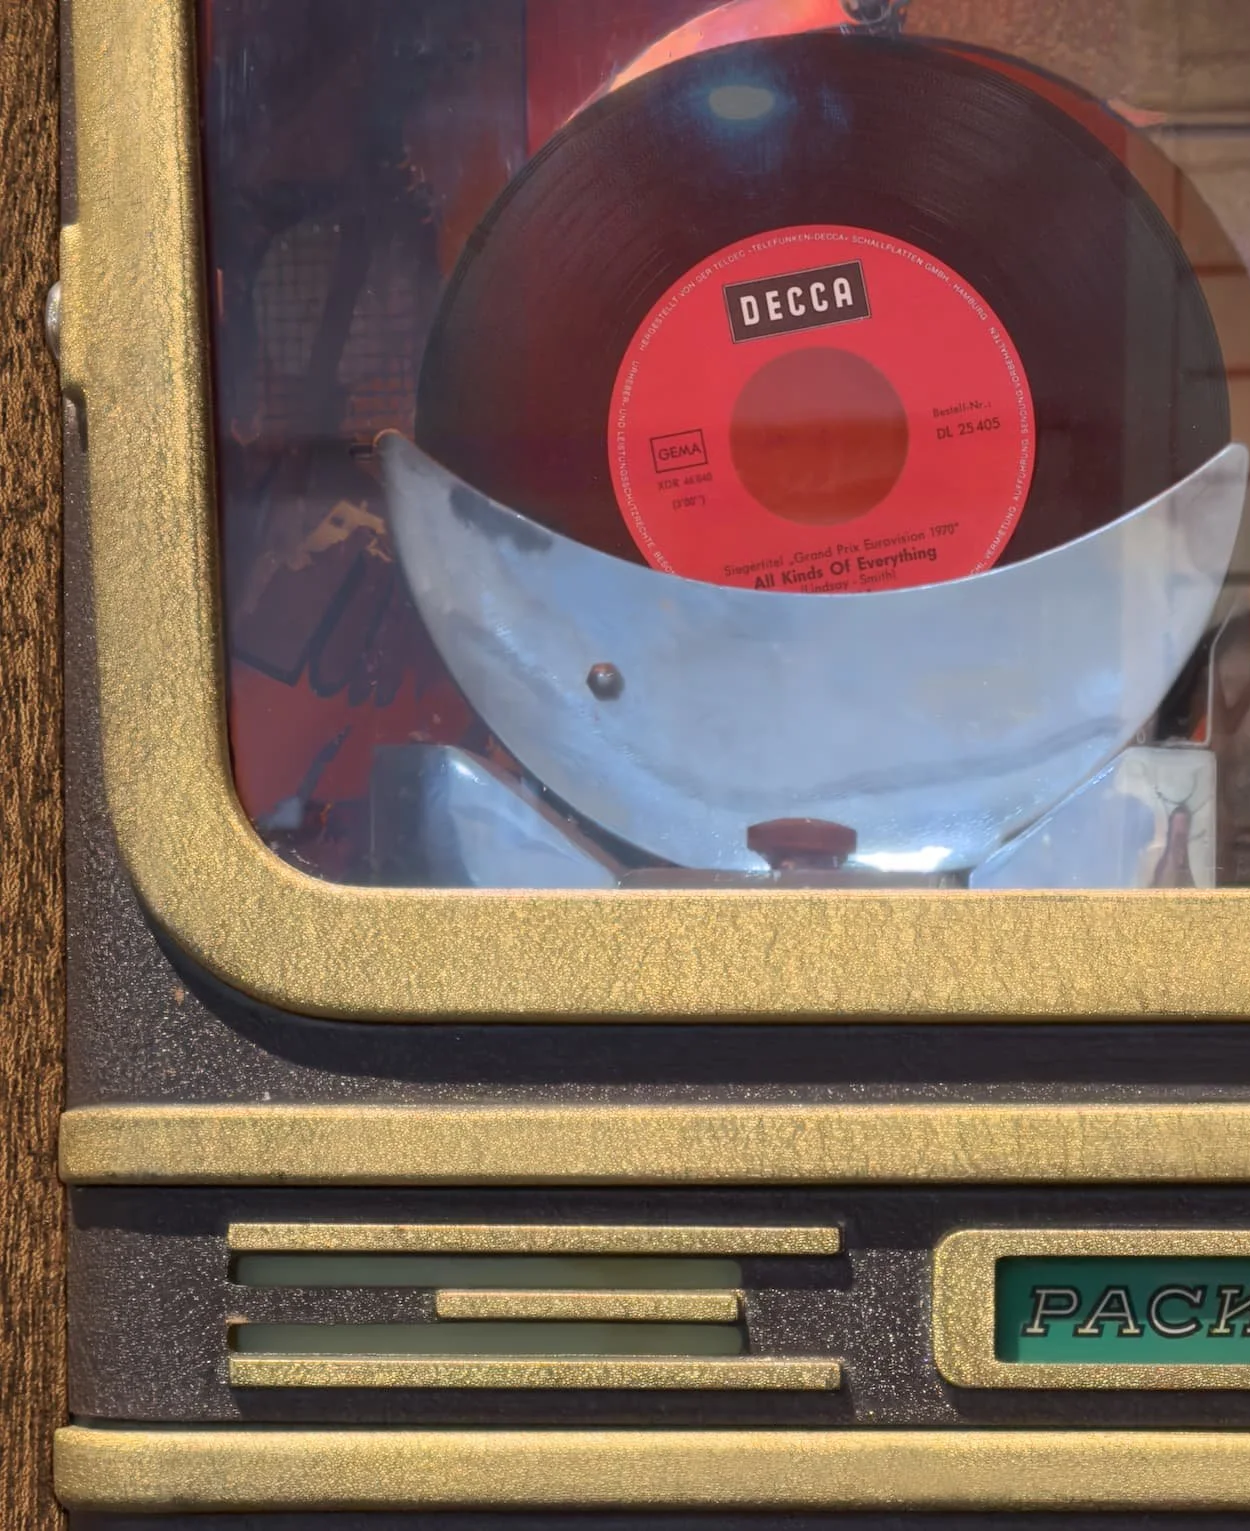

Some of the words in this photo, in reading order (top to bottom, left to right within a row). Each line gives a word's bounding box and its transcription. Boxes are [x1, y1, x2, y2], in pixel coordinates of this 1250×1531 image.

[679, 282, 696, 298] VON
[695, 268, 714, 284] DER
[851, 235, 924, 266] SCHALLPLATTEN
[953, 283, 988, 321] HAMBURG
[739, 277, 854, 326] DECCA
[617, 408, 627, 428] UND
[936, 425, 953, 440] DL
[658, 443, 702, 461] GEMA
[724, 556, 784, 577] Siegertitel
[837, 541, 860, 555] Prix
[864, 531, 926, 550] Eurovision
[754, 573, 775, 590] All
[782, 566, 824, 584] Kinds
[830, 559, 851, 576] Of
[858, 546, 938, 571] Everything
